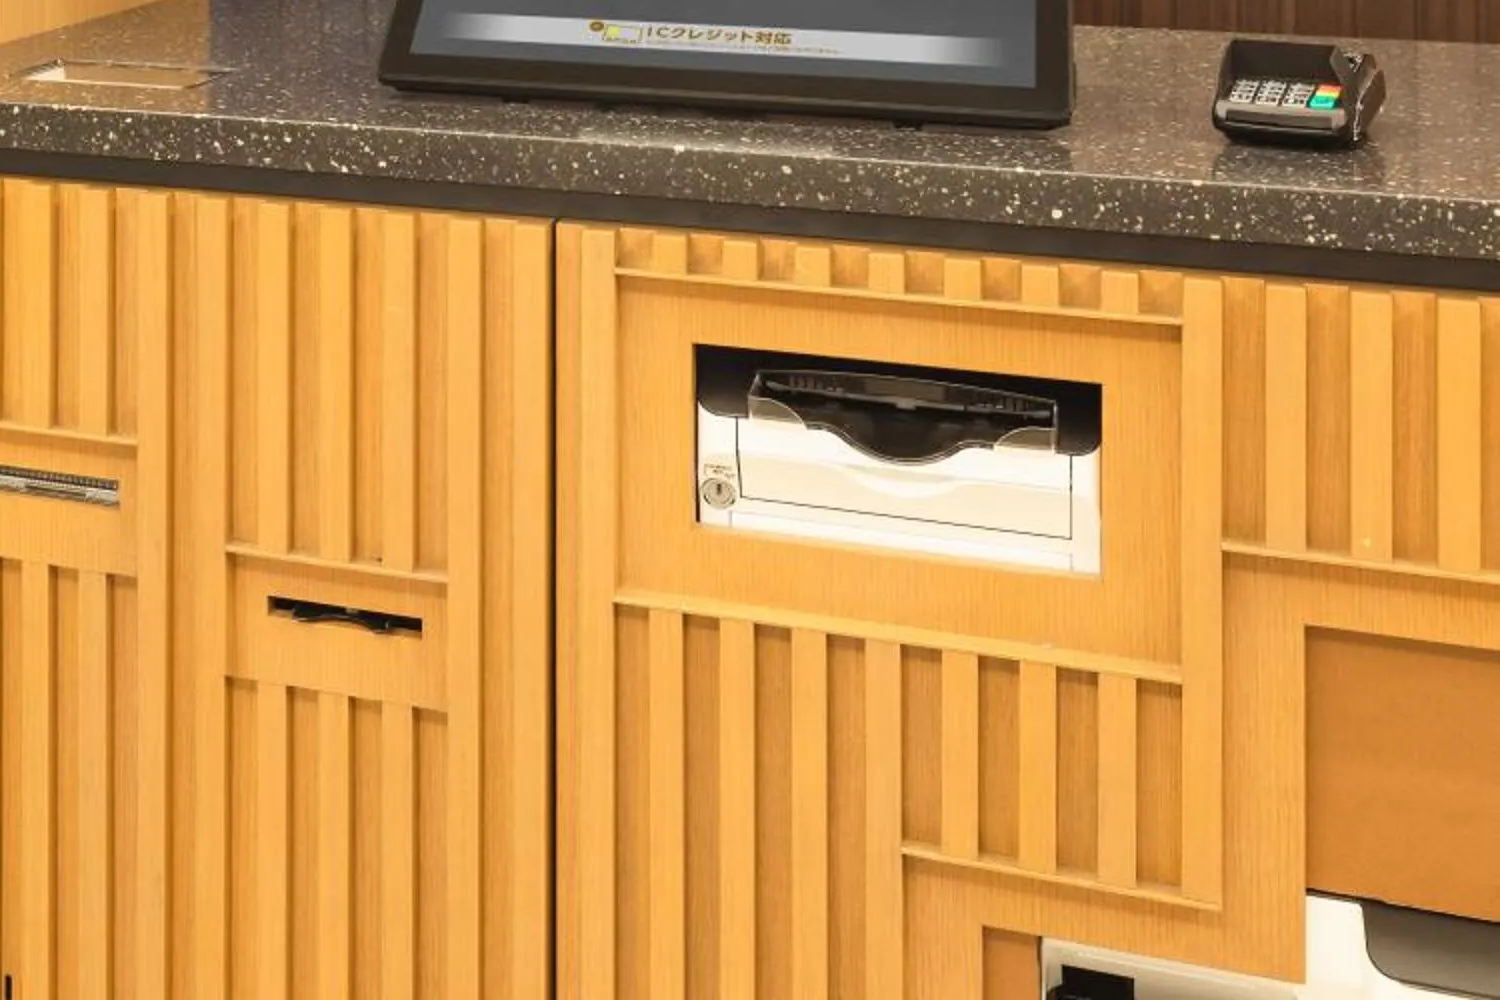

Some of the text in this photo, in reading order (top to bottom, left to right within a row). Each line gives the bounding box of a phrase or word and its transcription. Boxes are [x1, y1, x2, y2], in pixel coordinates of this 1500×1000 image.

[647, 25, 792, 46] ICクレジット対応
